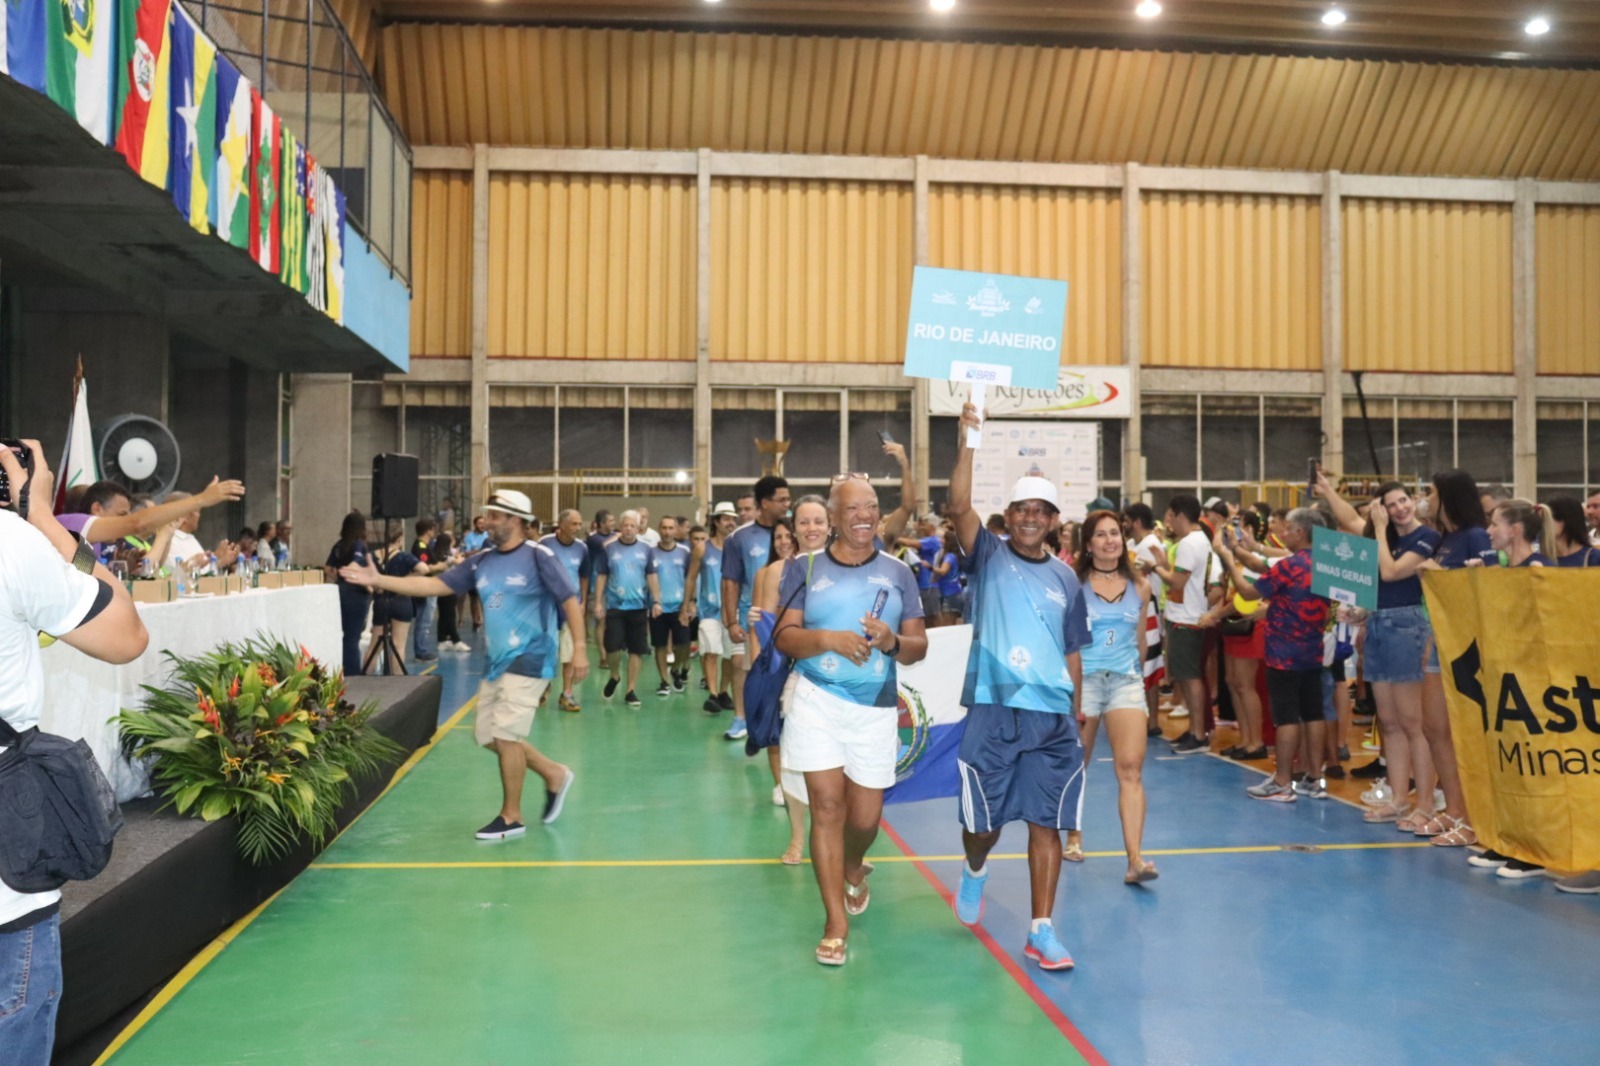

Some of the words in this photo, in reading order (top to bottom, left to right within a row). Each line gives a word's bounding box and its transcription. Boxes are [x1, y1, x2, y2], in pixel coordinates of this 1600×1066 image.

[914, 323, 945, 341] RIO
[950, 326, 974, 344] DE
[978, 331, 1057, 351] JANEIRO
[976, 370, 996, 381] BRB
[1316, 562, 1340, 578] MINAS
[1342, 569, 1373, 587] GERAIS
[1105, 630, 1115, 646] 3
[1494, 673, 1600, 735] Ast
